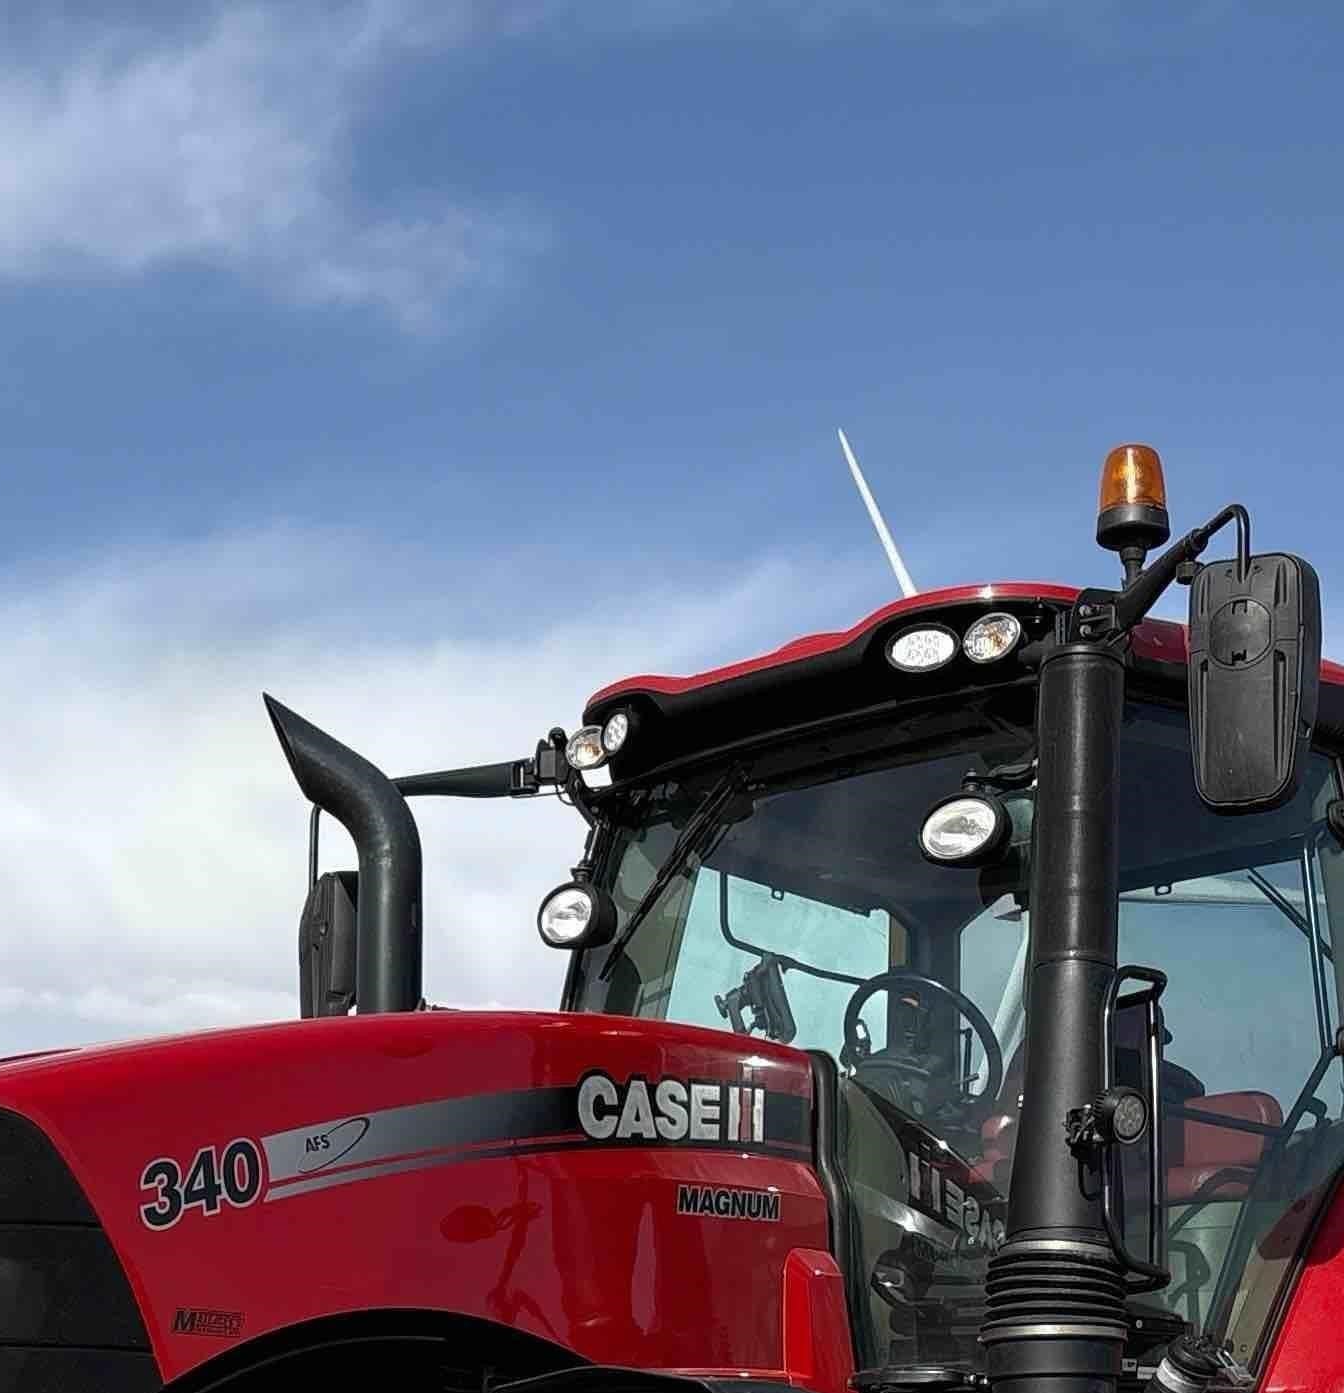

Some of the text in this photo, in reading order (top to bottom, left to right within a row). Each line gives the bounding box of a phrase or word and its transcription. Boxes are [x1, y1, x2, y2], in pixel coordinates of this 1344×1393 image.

[578, 1075, 720, 1140] CASE
[306, 1135, 331, 1152] AFS
[140, 1137, 262, 1231] 340
[677, 1184, 780, 1222] MAGNUM
